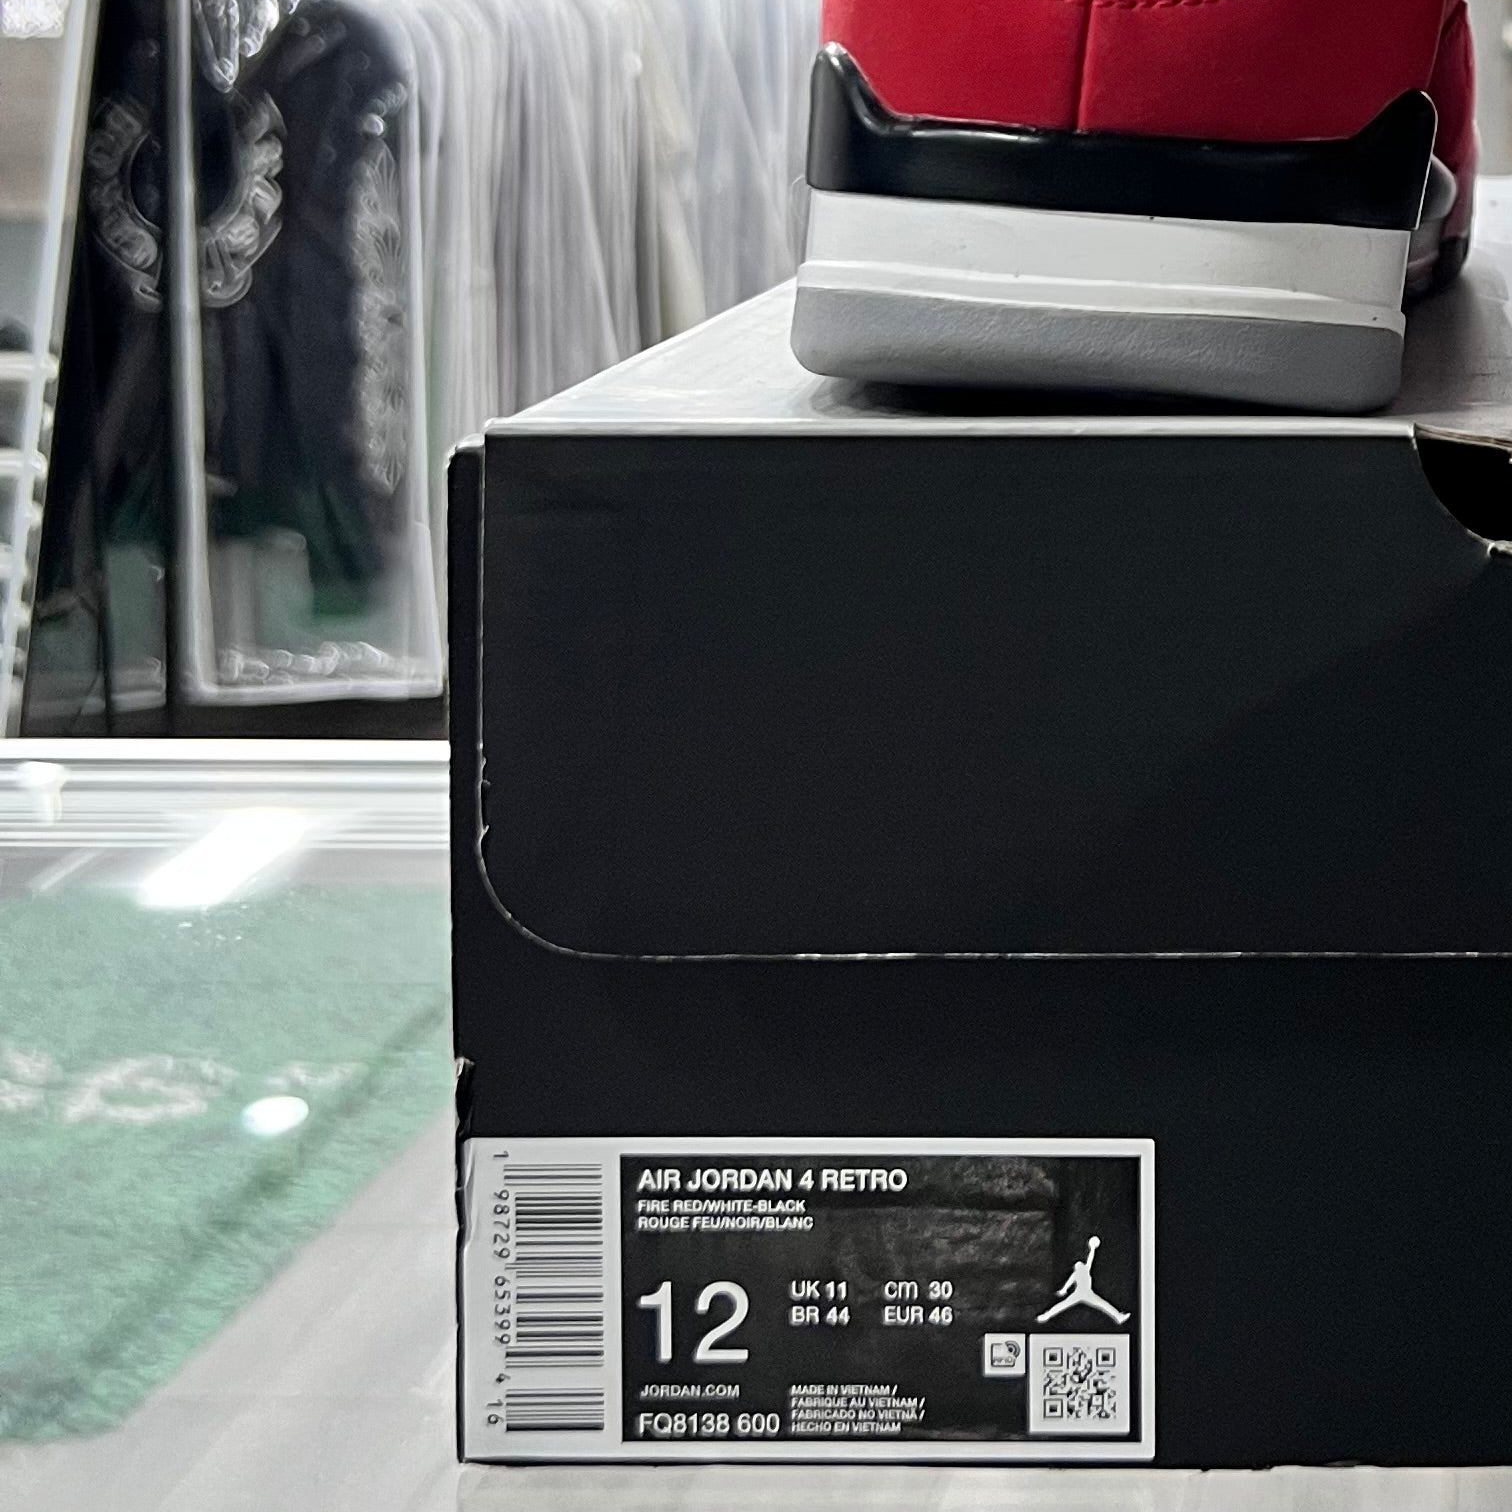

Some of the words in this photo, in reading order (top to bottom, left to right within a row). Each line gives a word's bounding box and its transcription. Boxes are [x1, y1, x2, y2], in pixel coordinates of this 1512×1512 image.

[638, 1168, 681, 1191] AIR
[688, 1168, 792, 1191] JORDAN
[799, 1168, 815, 1191] 4
[821, 1168, 908, 1191] RETRO
[637, 1199, 670, 1213] FIRE
[673, 1199, 806, 1213] RED/WHITE-BLACK
[494, 1190, 511, 1259] 98729
[637, 1216, 690, 1230] ROUGE
[692, 1216, 814, 1230] FEU/NOIR/BLANC
[790, 1280, 820, 1300] UK
[825, 1280, 848, 1300] 11
[928, 1281, 953, 1300] 30
[495, 1276, 511, 1345] 65399
[790, 1306, 820, 1326] BR
[825, 1306, 851, 1326] 44
[883, 1306, 924, 1326] EUR
[928, 1306, 953, 1326] 46
[638, 1281, 749, 1363] 12
[640, 1384, 740, 1398] JORDAN.COM
[791, 1384, 825, 1395] MADE
[827, 1384, 838, 1395] IN
[840, 1384, 890, 1395] VIETNAM
[791, 1397, 848, 1408] FABRIQUE
[849, 1397, 866, 1408] AU
[869, 1397, 918, 1408] VIETNAM
[638, 1413, 730, 1434] FQ8138
[736, 1413, 780, 1434] 600
[791, 1409, 855, 1420] FABRICADO
[858, 1409, 875, 1420] NO
[791, 1422, 831, 1433] HECHO
[834, 1422, 850, 1433] EN
[852, 1422, 901, 1433] VIETNAM
